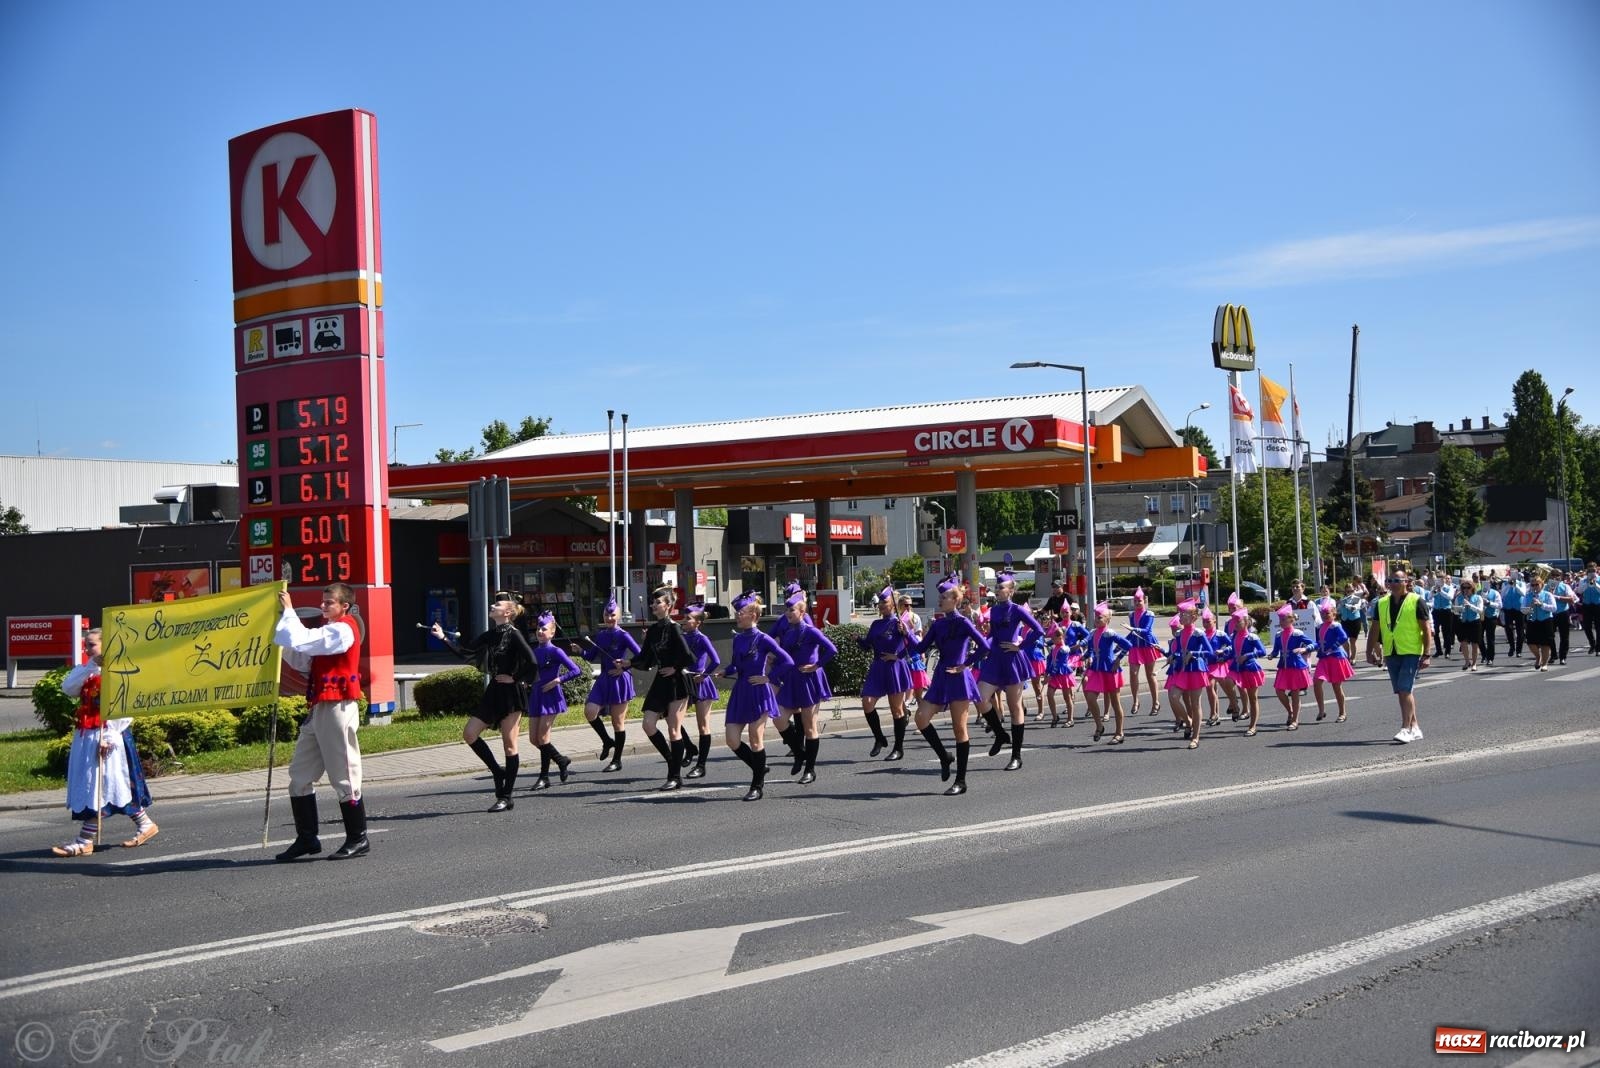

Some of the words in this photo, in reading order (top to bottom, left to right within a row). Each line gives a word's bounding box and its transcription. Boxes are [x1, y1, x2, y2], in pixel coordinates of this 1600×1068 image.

[258, 151, 328, 258] K
[253, 407, 262, 422] D
[297, 396, 348, 429] 5.79
[914, 427, 997, 452] CIRCLE
[1009, 424, 1032, 451] K
[252, 443, 266, 458] 95
[297, 433, 349, 466] 5.72
[255, 480, 264, 495] D
[300, 471, 349, 502] 6.14
[254, 522, 267, 536] 95
[301, 514, 350, 545] 6.07
[805, 523, 863, 535] REURACJA
[1055, 514, 1076, 526] TIR
[571, 542, 596, 552] CIRCLE
[1505, 529, 1544, 546] ZDZ
[251, 558, 273, 574] LPG
[301, 552, 351, 583] 2.79
[145, 608, 249, 641] Stowarzyszenie
[170, 687, 208, 705] KRAINA
[214, 684, 243, 700] WIELU
